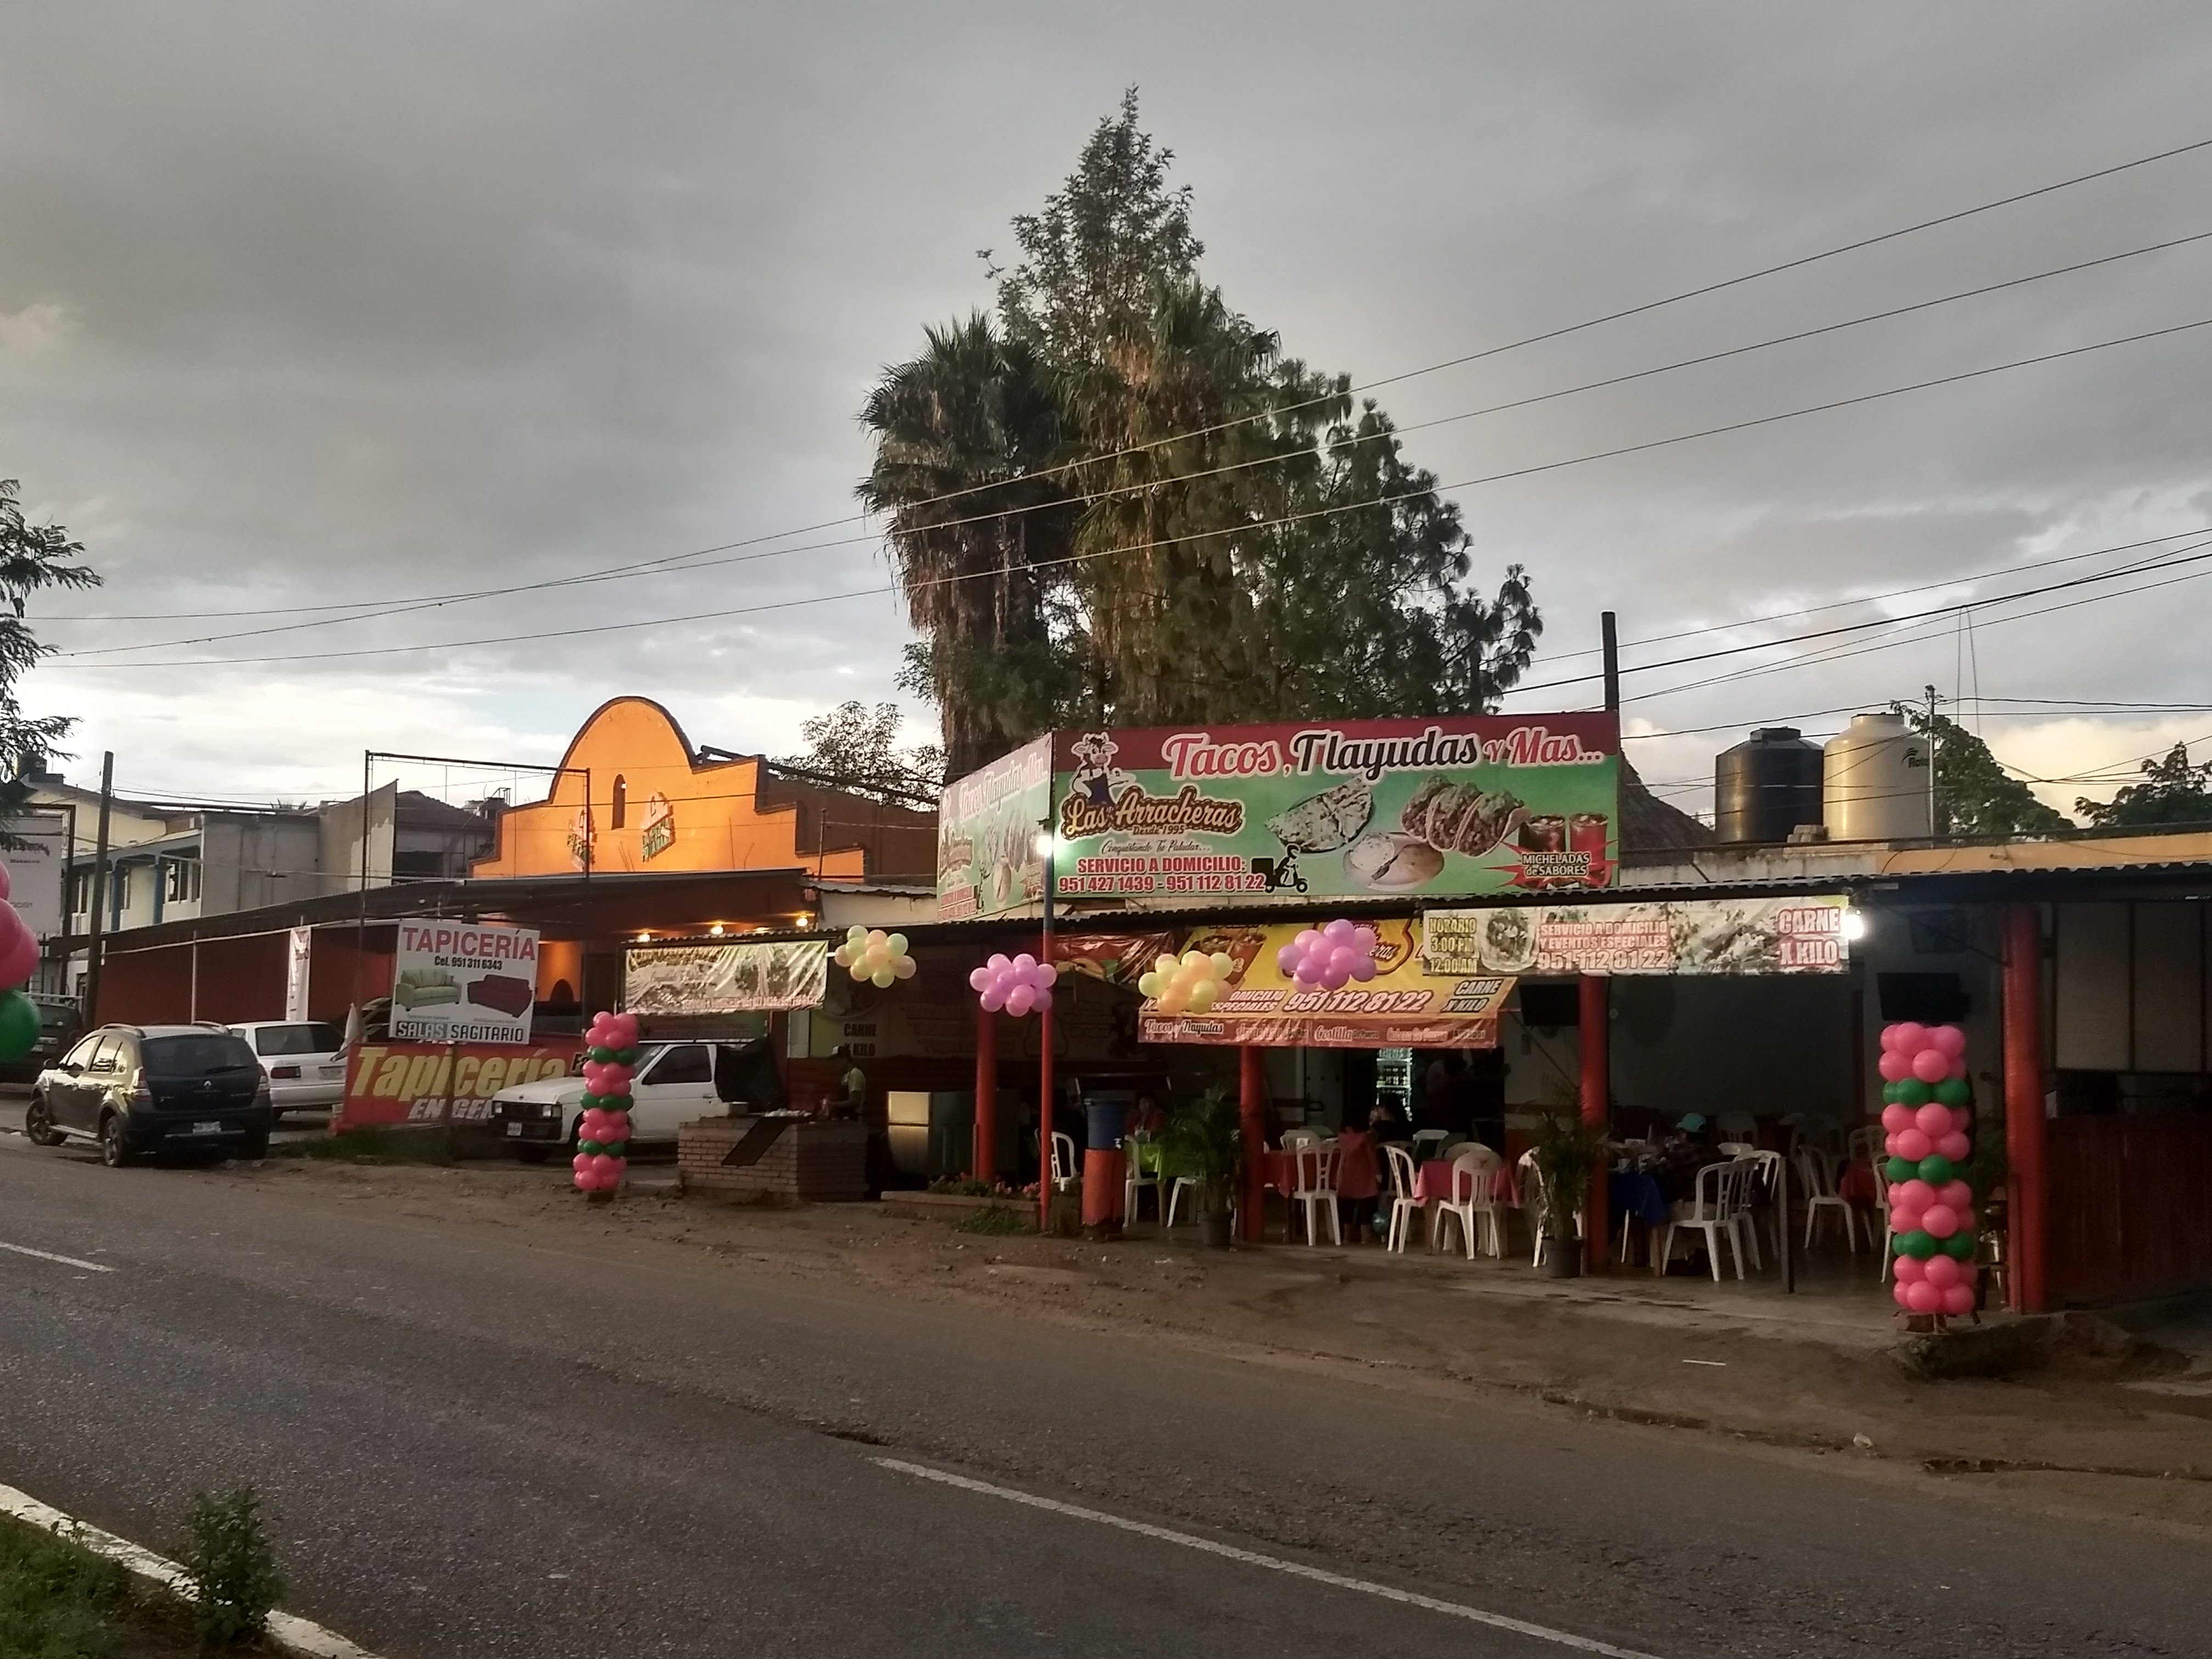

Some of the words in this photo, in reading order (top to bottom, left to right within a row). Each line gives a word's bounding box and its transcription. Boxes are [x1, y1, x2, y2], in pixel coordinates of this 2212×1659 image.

[1291, 729, 1480, 782] Tlayudas
[1066, 798, 1107, 834] Las
[1115, 791, 1239, 828] Arracheras
[1132, 826, 1160, 835] Desde
[1162, 825, 1185, 834] 1995
[1102, 839, 1152, 856] Conquistando
[1077, 857, 1146, 874] SERVICIO
[1149, 857, 1159, 873] A
[1162, 856, 1246, 873] DOMICILIO:
[1522, 853, 1590, 865] MICHELADAS
[1526, 866, 1538, 876] de
[1538, 865, 1588, 876] SABORES
[1059, 877, 1086, 893] 951
[1088, 877, 1114, 892] 427
[1118, 876, 1155, 891] 1439
[1166, 876, 1193, 891] 951
[1196, 876, 1222, 891] 112
[1224, 876, 1242, 890] 81
[1245, 875, 1265, 890] 22
[1429, 917, 1477, 934] HORARIO
[1540, 923, 1593, 936] SERVICIO
[1595, 922, 1603, 935] A
[1605, 921, 1668, 935] DOMICILIO
[1778, 907, 1841, 934] CARNE
[403, 927, 535, 961] TAPICERÍA
[1430, 935, 1456, 952] 3:00
[1539, 936, 1547, 950] Y
[1548, 936, 1599, 949] EVENTOS
[1600, 934, 1668, 949] ESPECIALES
[1613, 949, 1638, 969] 81
[1641, 949, 1669, 969] 22
[1780, 940, 1793, 966] X
[1795, 939, 1838, 966] KILO
[434, 955, 450, 966] Cel.
[452, 957, 466, 968] 951
[466, 958, 481, 969] 311
[482, 958, 503, 971] 6343
[1429, 957, 1458, 973] 12:00
[1459, 957, 1477, 974] AM
[1228, 989, 1288, 1002] OMICILIO
[1454, 979, 1504, 996] CARNE
[1282, 989, 1331, 1012] 951
[1323, 989, 1371, 1013] 112
[1362, 989, 1403, 1013] 81
[1390, 989, 1435, 1013] 22
[1451, 997, 1490, 1013] KILO
[397, 1021, 447, 1037] SALAS
[450, 1024, 524, 1042] SAGITARIO
[844, 1023, 877, 1036] CARNE
[1144, 1019, 1173, 1034] Tacos
[1314, 1025, 1353, 1042] Costilla
[853, 1043, 876, 1056] KILO
[351, 1047, 566, 1102] Tapicería
[407, 1098, 447, 1120] EN
